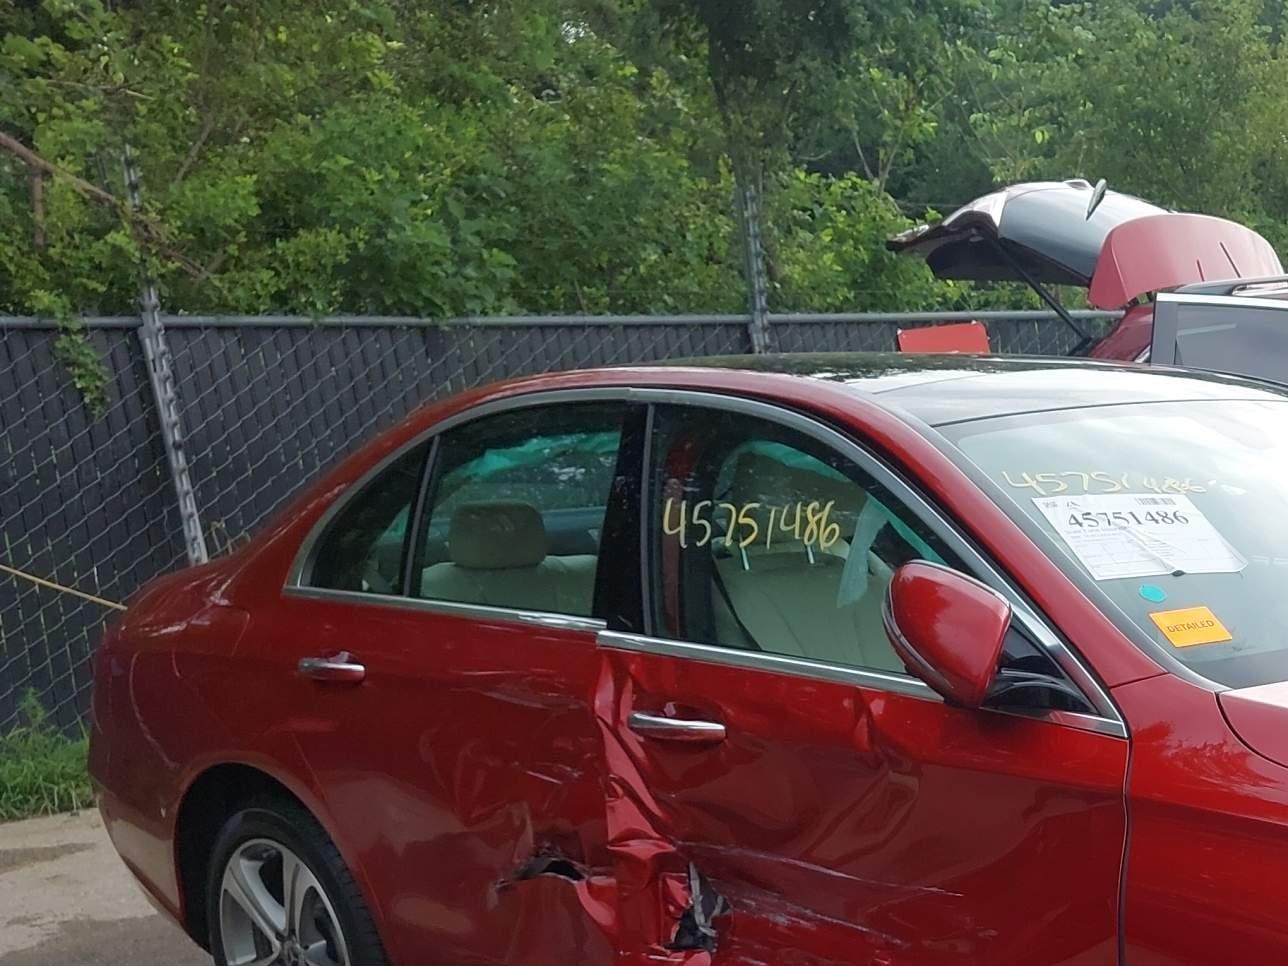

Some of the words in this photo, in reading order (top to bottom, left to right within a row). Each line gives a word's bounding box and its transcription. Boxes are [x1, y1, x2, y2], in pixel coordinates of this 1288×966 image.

[662, 497, 841, 550] 45751486
[1068, 510, 1190, 528] 45751486
[1166, 619, 1215, 633] DETAILED
